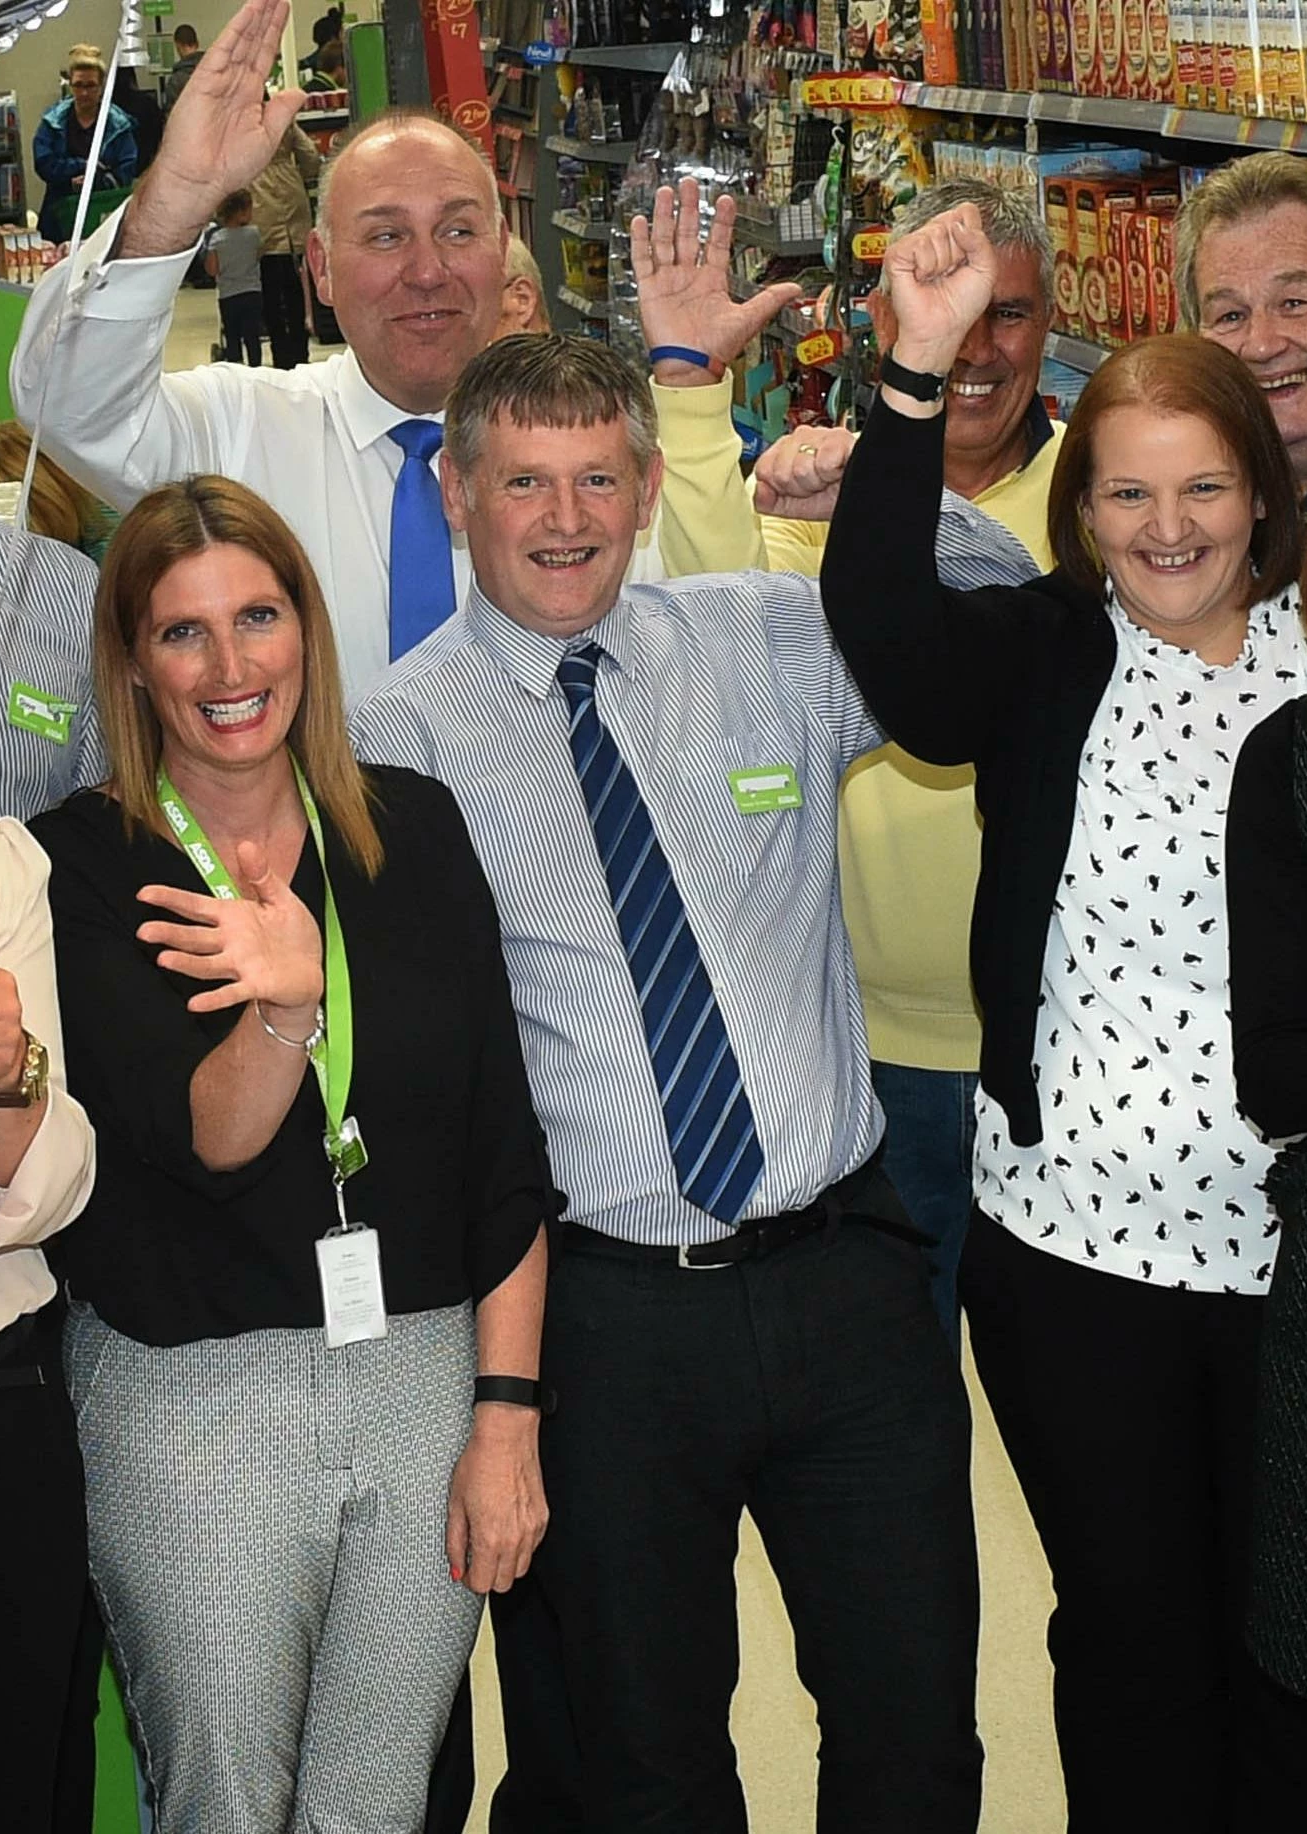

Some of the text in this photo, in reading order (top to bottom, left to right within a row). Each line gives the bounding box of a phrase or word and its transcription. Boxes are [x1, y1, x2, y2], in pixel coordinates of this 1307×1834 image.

[527, 47, 553, 58] New!
[161, 798, 189, 836] ASDA
[187, 842, 215, 876] ASDA
